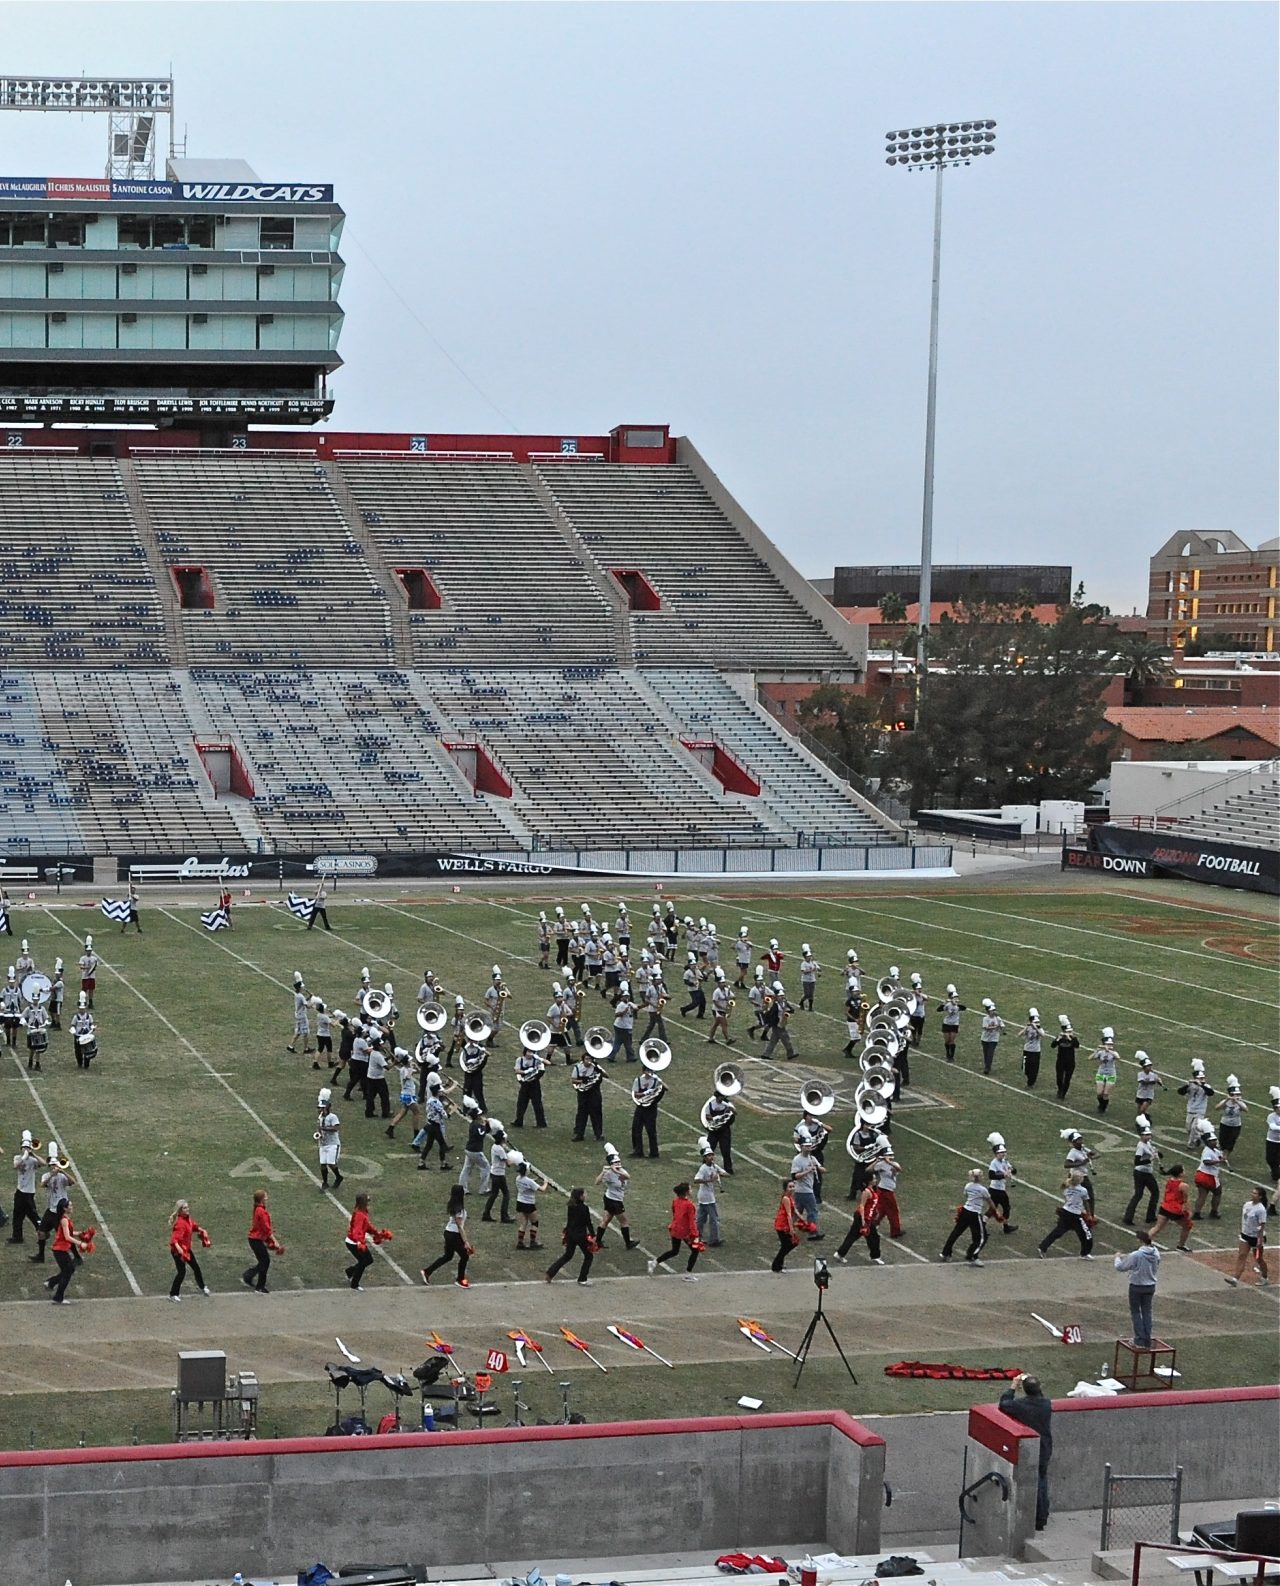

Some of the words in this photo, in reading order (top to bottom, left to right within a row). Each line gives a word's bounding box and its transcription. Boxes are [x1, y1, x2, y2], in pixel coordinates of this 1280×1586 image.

[10, 183, 47, 192] McLAUGHLIN
[55, 183, 75, 192] CHRIS
[76, 183, 111, 193] McALISTER
[112, 183, 117, 193] 5
[118, 184, 147, 194] ANTOINE
[148, 184, 173, 195] CASON
[183, 184, 325, 201] WILDCATS
[7, 436, 23, 447] 22
[232, 438, 247, 449] 23
[411, 441, 426, 452] 24
[562, 443, 576, 454] 25
[437, 858, 495, 872] WELLS
[1102, 856, 1147, 874] DOWN
[1197, 853, 1261, 876] FOOTBALL
[1065, 1326, 1082, 1343] 30
[488, 1351, 505, 1371] 40
